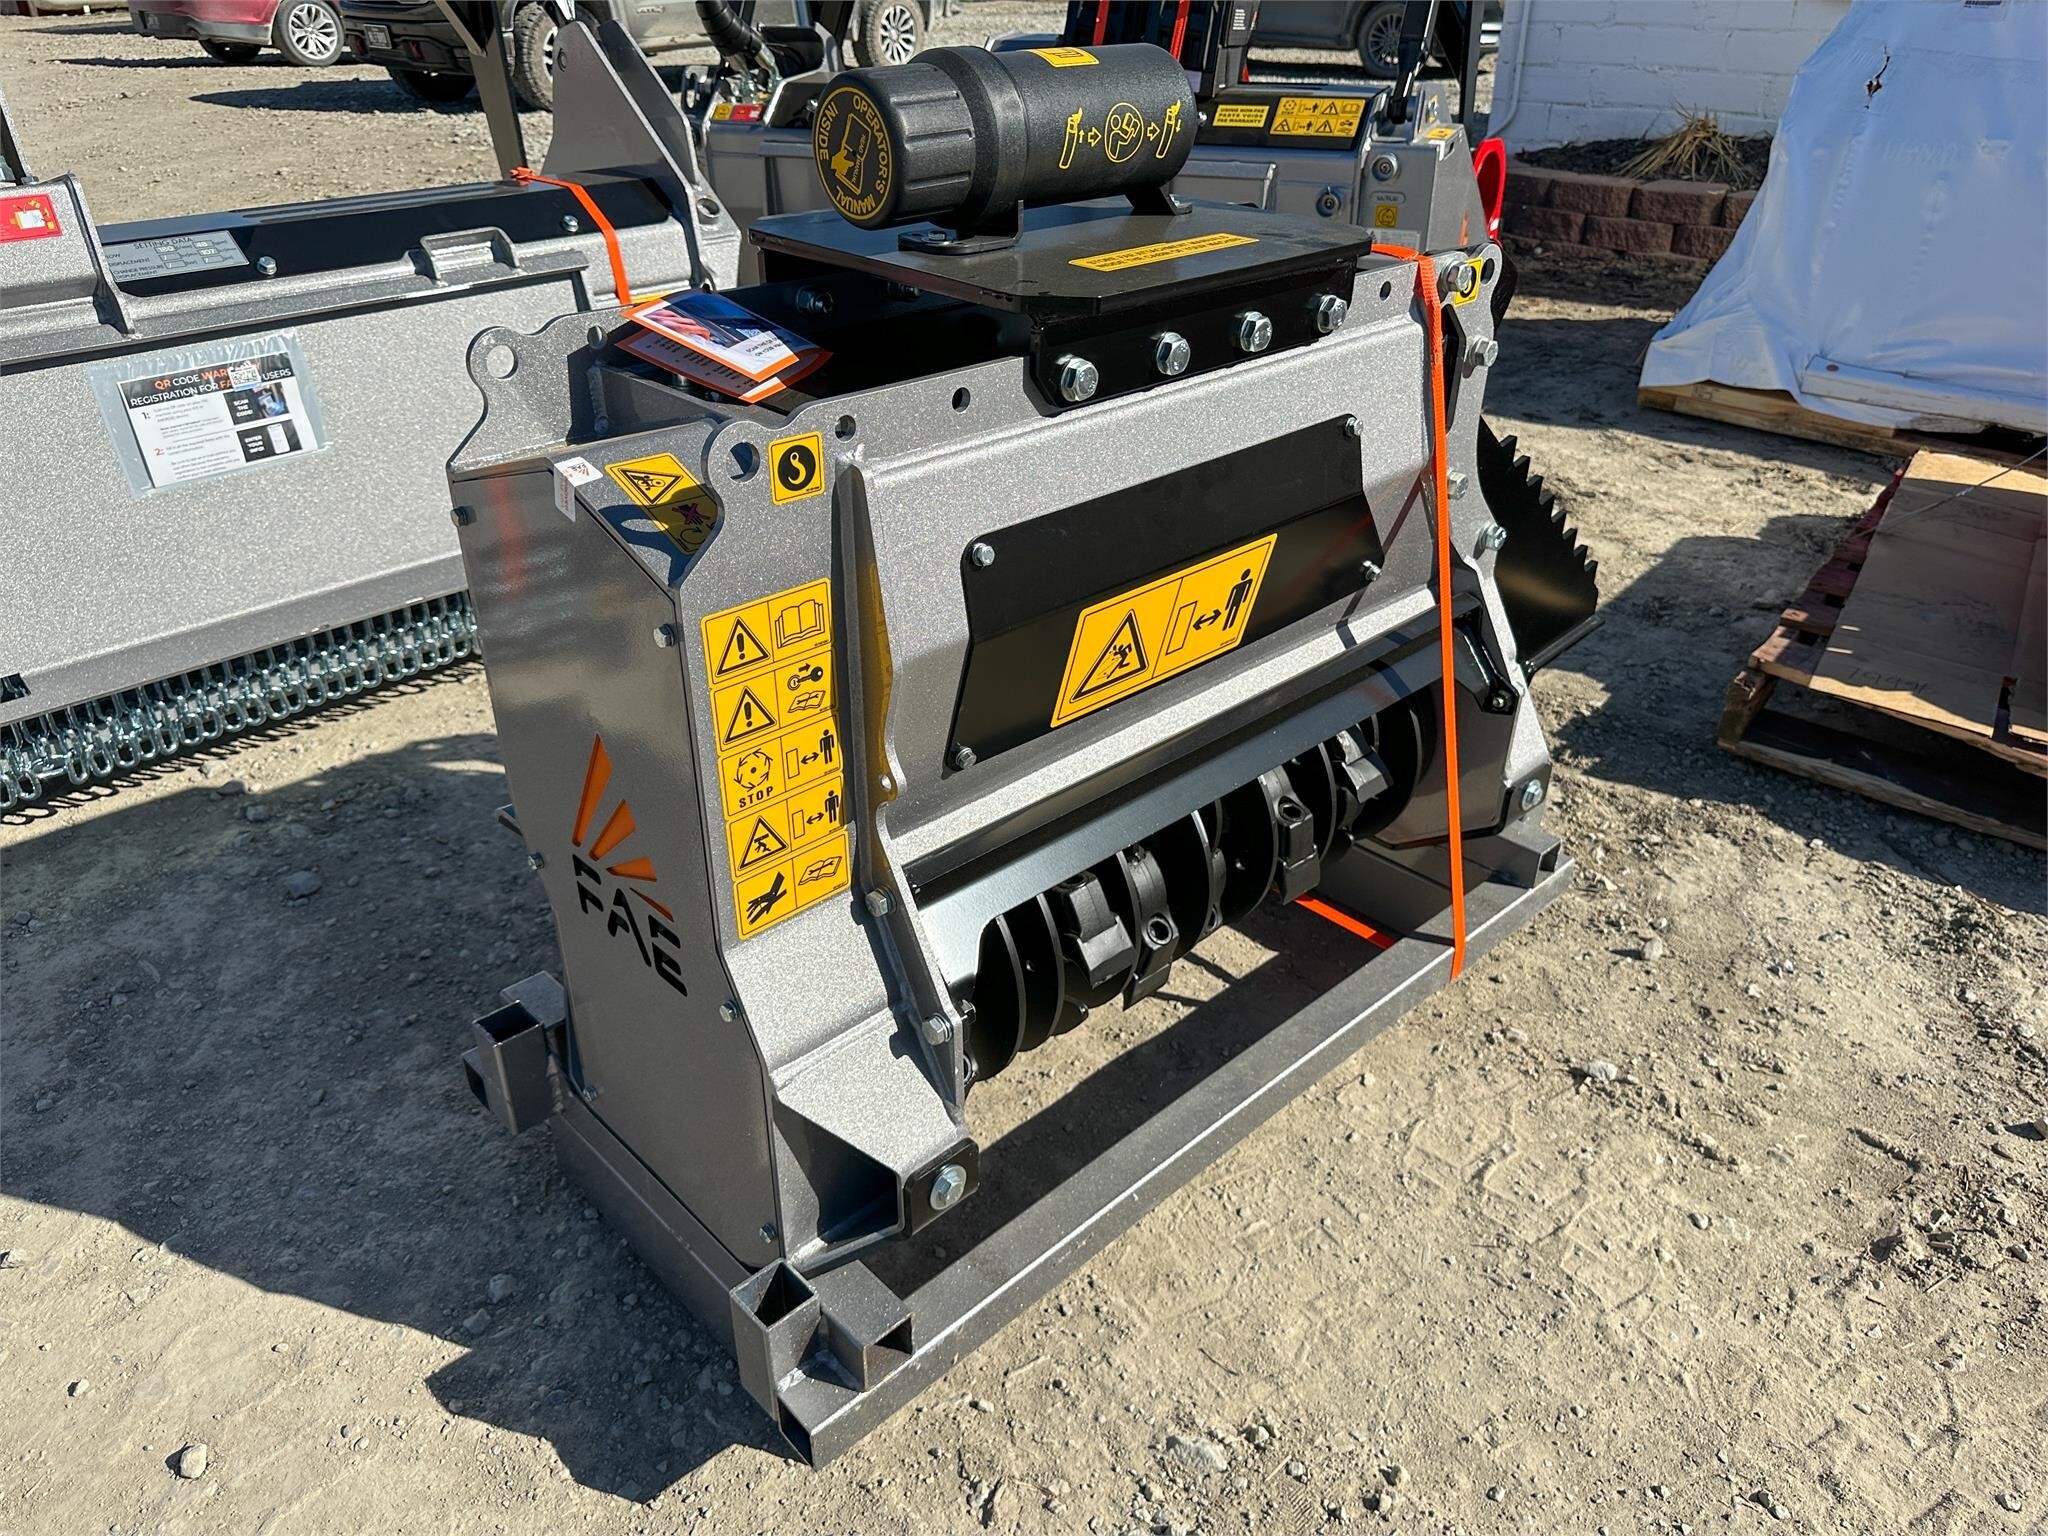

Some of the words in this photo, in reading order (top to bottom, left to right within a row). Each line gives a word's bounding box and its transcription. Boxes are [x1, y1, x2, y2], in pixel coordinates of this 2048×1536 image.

[820, 102, 838, 160] INSIDE
[852, 95, 888, 194] OPERATOR'S
[836, 185, 876, 214] MANUAL
[133, 240, 170, 250] SETTING
[170, 237, 194, 246] DATA
[130, 387, 198, 407] REGISTRATION
[199, 383, 219, 396] FOR
[262, 368, 292, 381] USERS
[154, 379, 172, 390] QR
[172, 374, 200, 387] CODE
[739, 786, 773, 808] STOP
[572, 854, 688, 997] FAE
